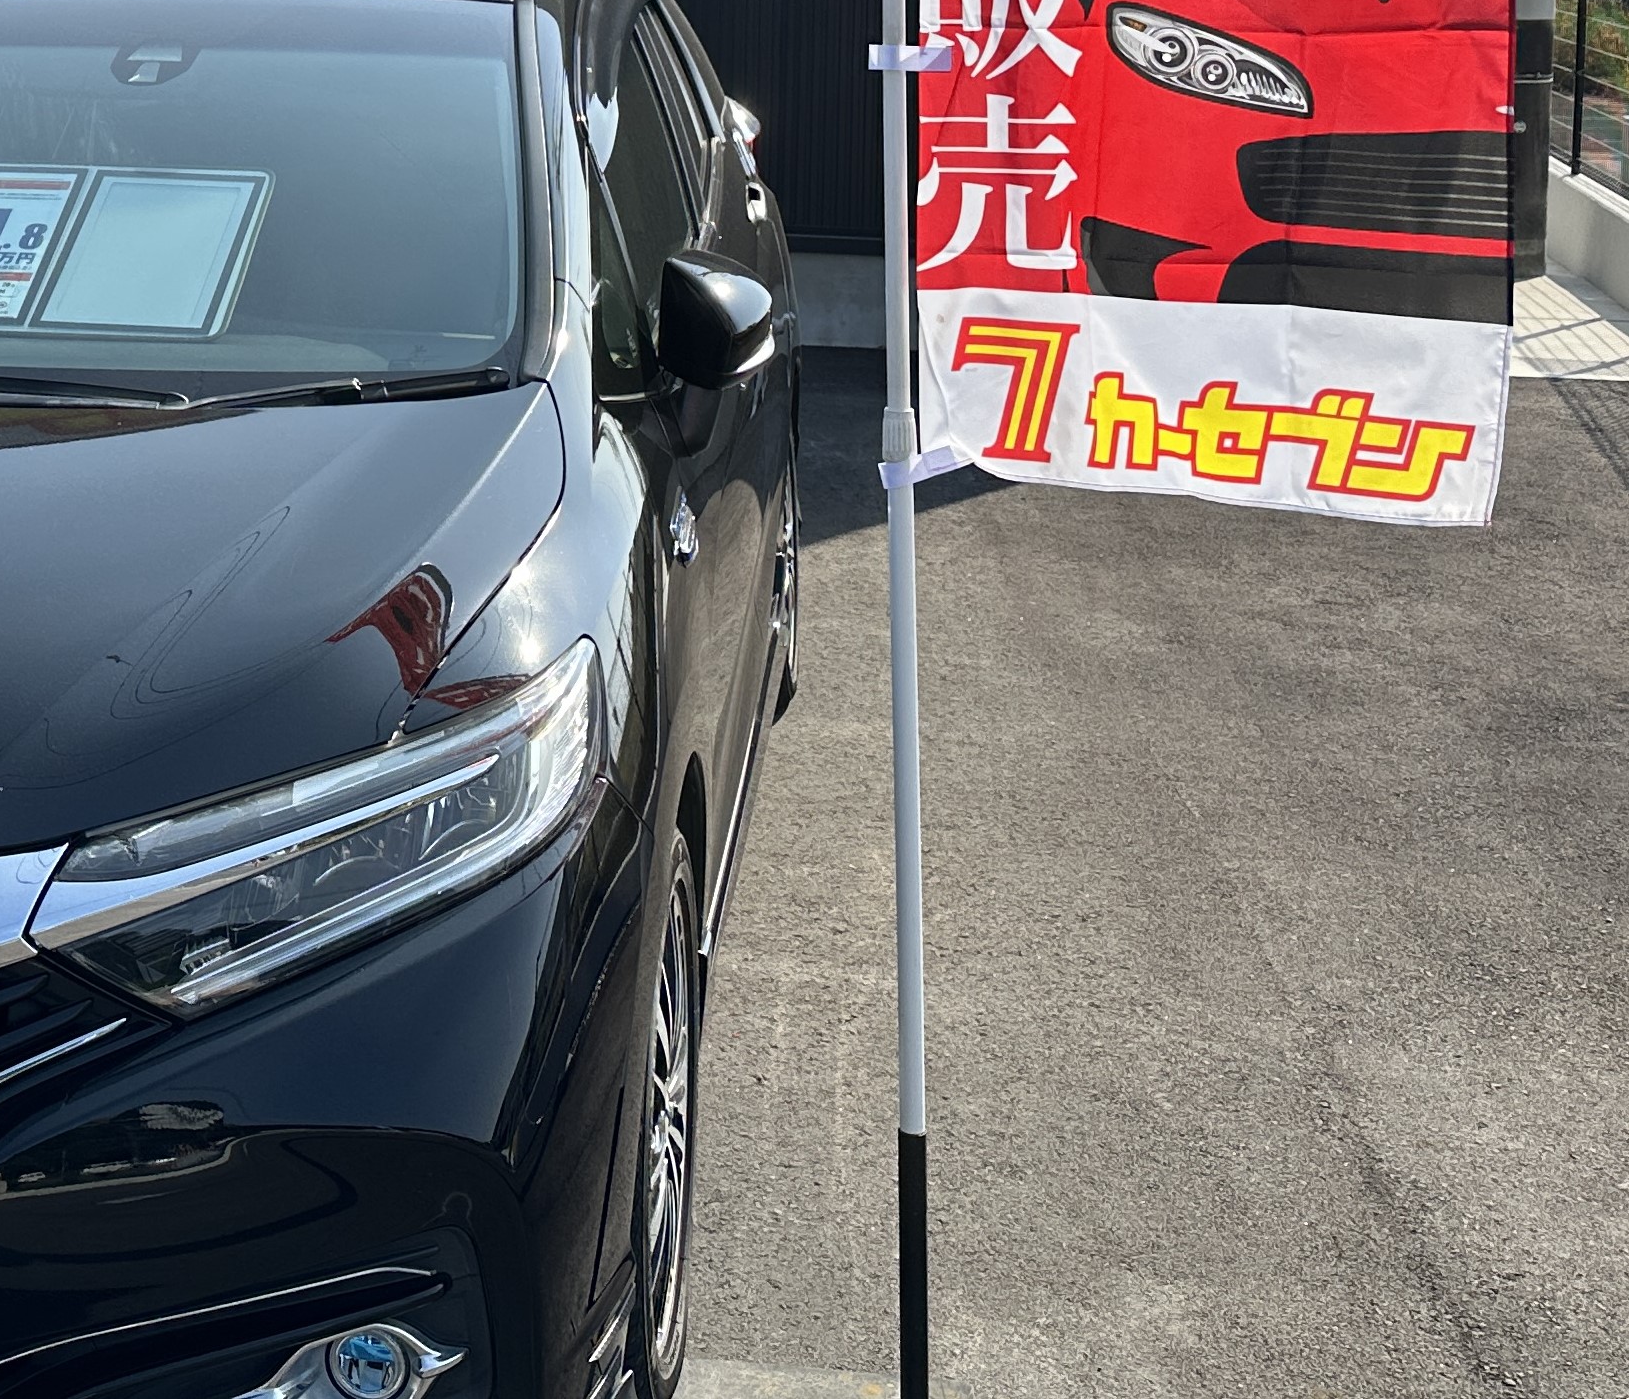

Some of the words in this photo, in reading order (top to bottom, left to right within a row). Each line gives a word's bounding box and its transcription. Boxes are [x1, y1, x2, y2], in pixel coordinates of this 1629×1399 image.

[1084, 371, 1476, 502] カーセブン
